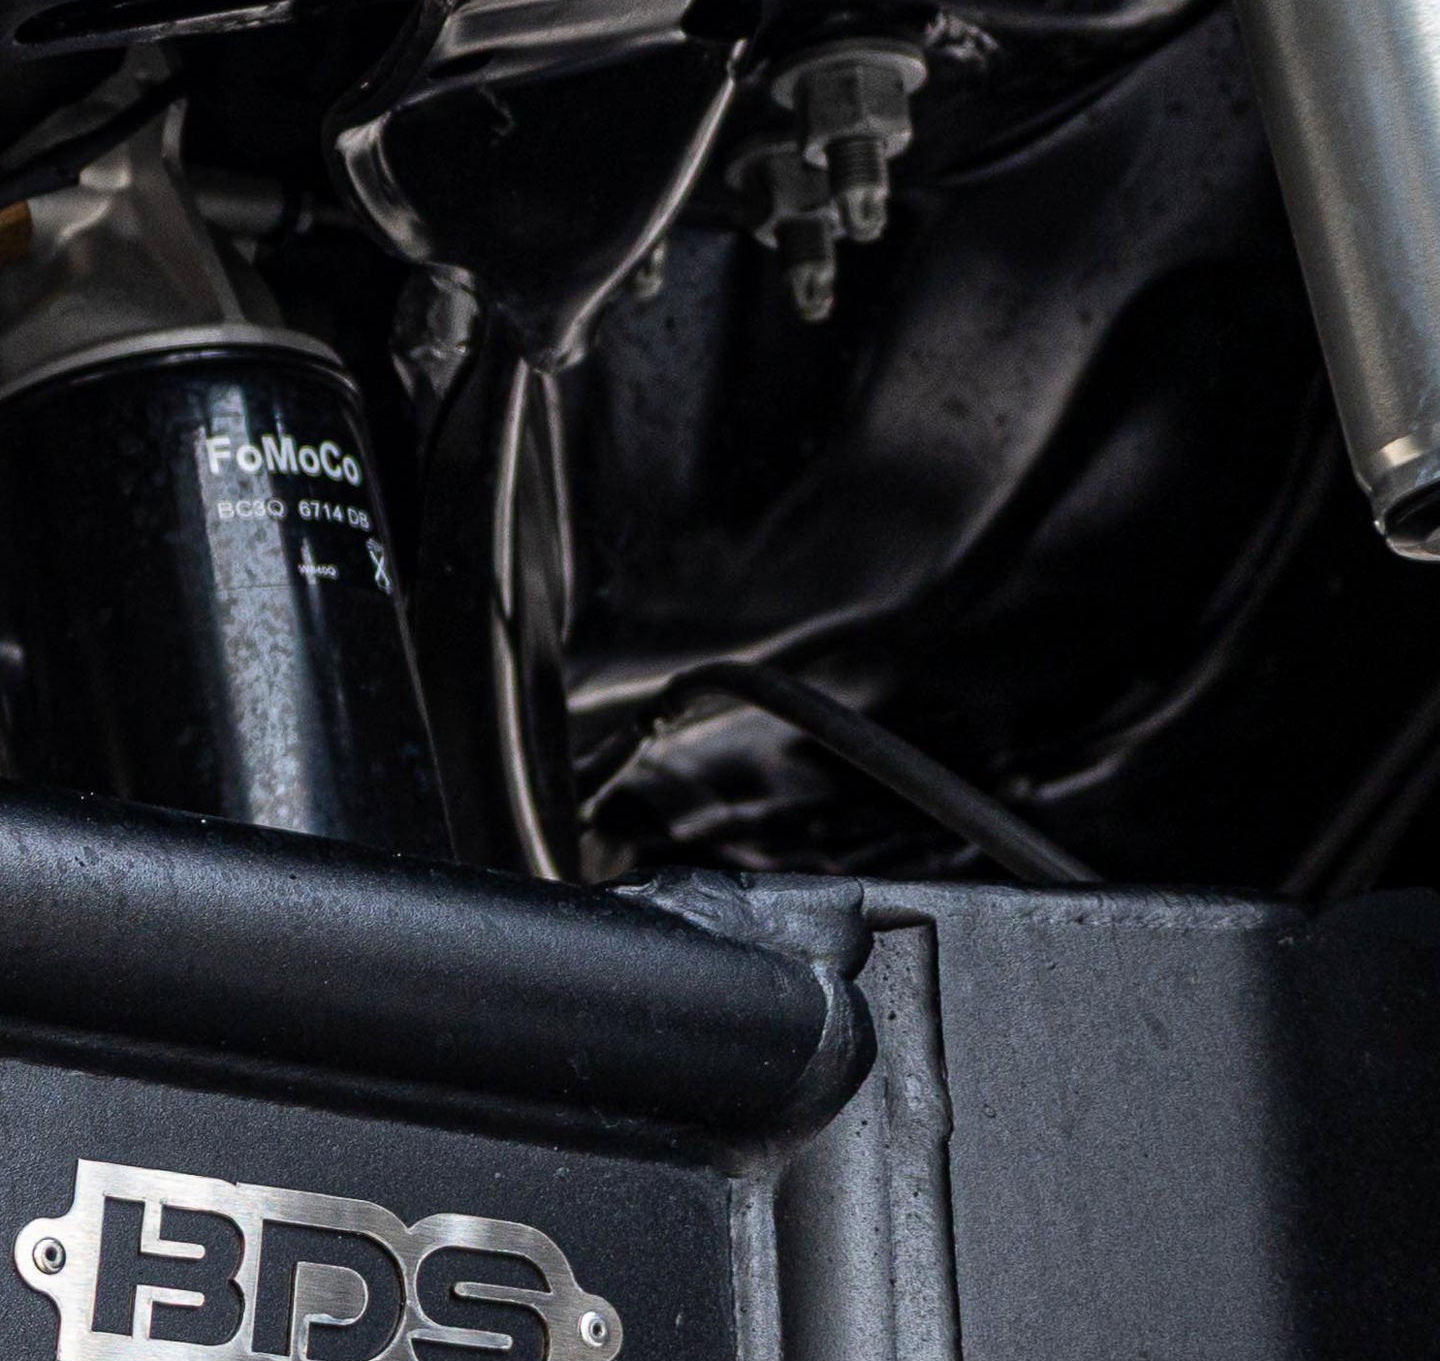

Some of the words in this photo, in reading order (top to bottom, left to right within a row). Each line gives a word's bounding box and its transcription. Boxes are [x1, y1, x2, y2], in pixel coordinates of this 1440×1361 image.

[206, 434, 361, 487] FoMoCo
[218, 499, 285, 520] BC3Q
[298, 501, 344, 523] 6714
